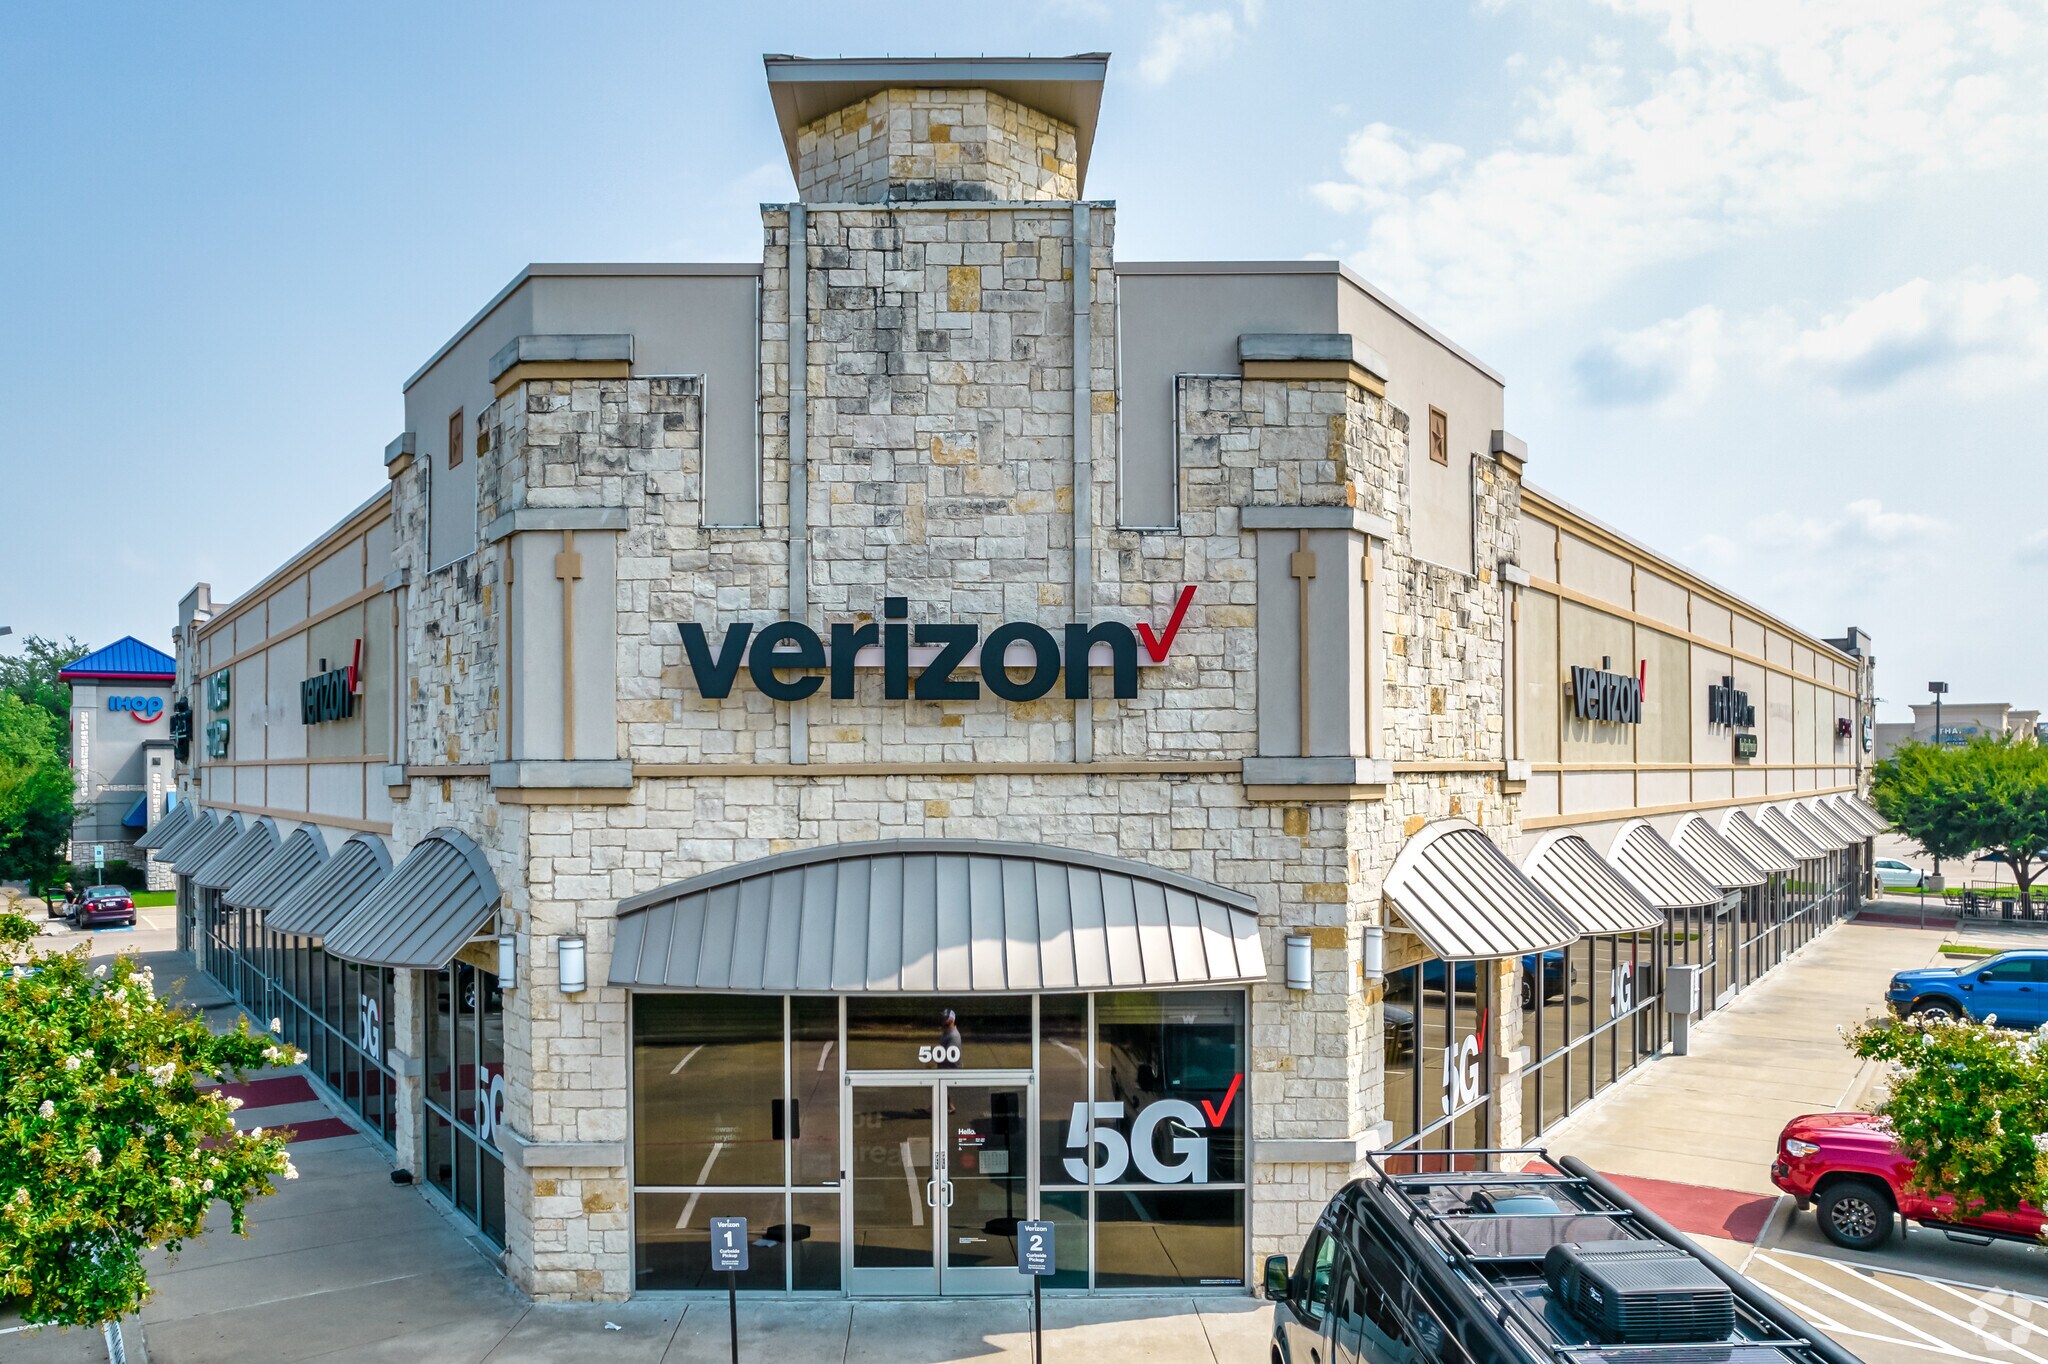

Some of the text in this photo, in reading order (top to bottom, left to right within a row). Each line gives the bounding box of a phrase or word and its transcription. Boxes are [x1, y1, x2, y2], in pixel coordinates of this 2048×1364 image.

[676, 597, 1138, 701] verizon
[300, 658, 351, 725] verizon
[1571, 656, 1641, 724] verizon
[109, 696, 163, 717] IHOP
[918, 1045, 961, 1063] 500
[1441, 1034, 1479, 1116] 5G
[1062, 1098, 1209, 1184] 5G
[717, 1219, 740, 1228] Verizon
[1024, 1223, 1047, 1232] Verizon
[723, 1230, 733, 1247] 1
[1029, 1234, 1043, 1252] 2
